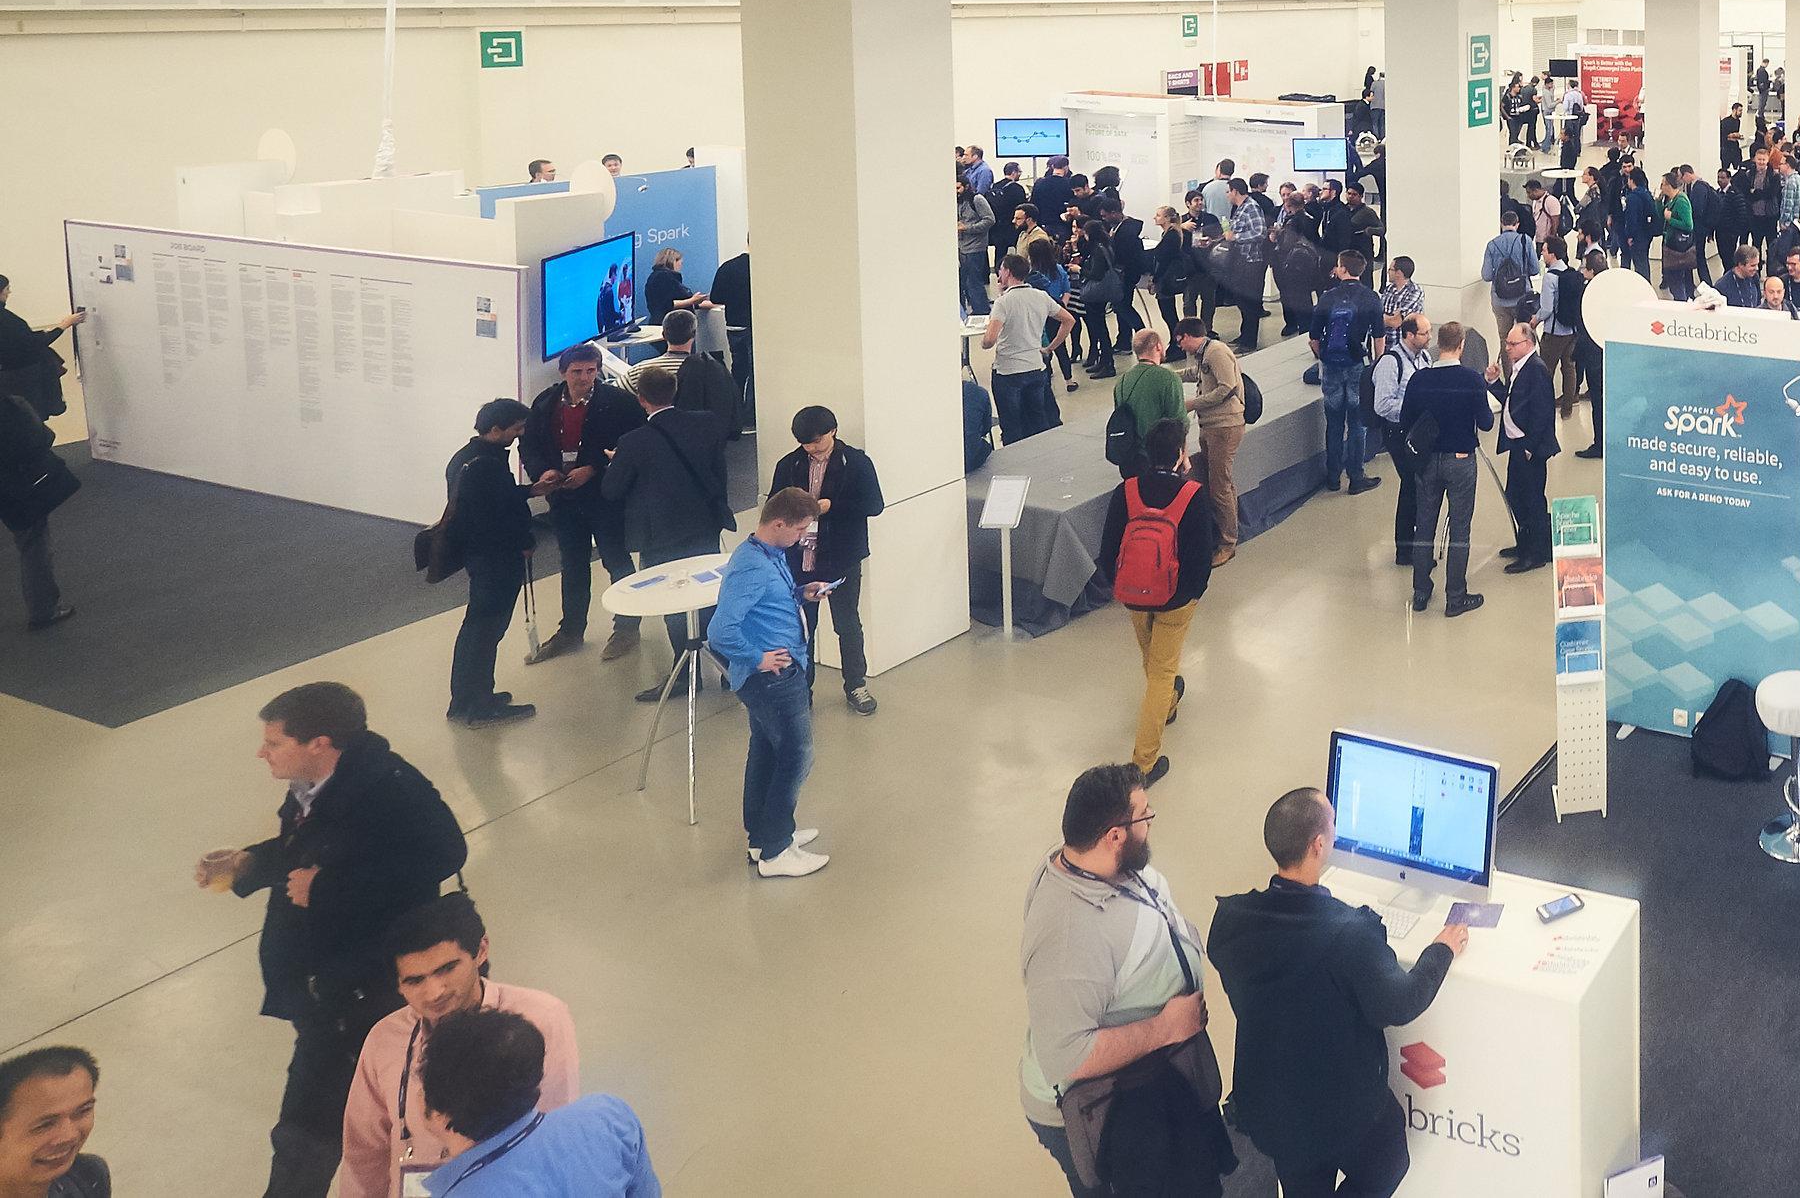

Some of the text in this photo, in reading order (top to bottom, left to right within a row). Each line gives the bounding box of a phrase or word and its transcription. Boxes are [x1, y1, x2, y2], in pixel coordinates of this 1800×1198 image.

[647, 223, 690, 245] Spark
[1666, 319, 1758, 344] databricks
[1664, 405, 1739, 438] Spark
[1682, 405, 1714, 415] APACHE
[1627, 436, 1783, 470] made secure, reliable,
[1650, 459, 1762, 485] and easy to use.
[1656, 487, 1751, 508] ASK FOR A DEMO TODAY
[1404, 1094, 1521, 1156] bricks
